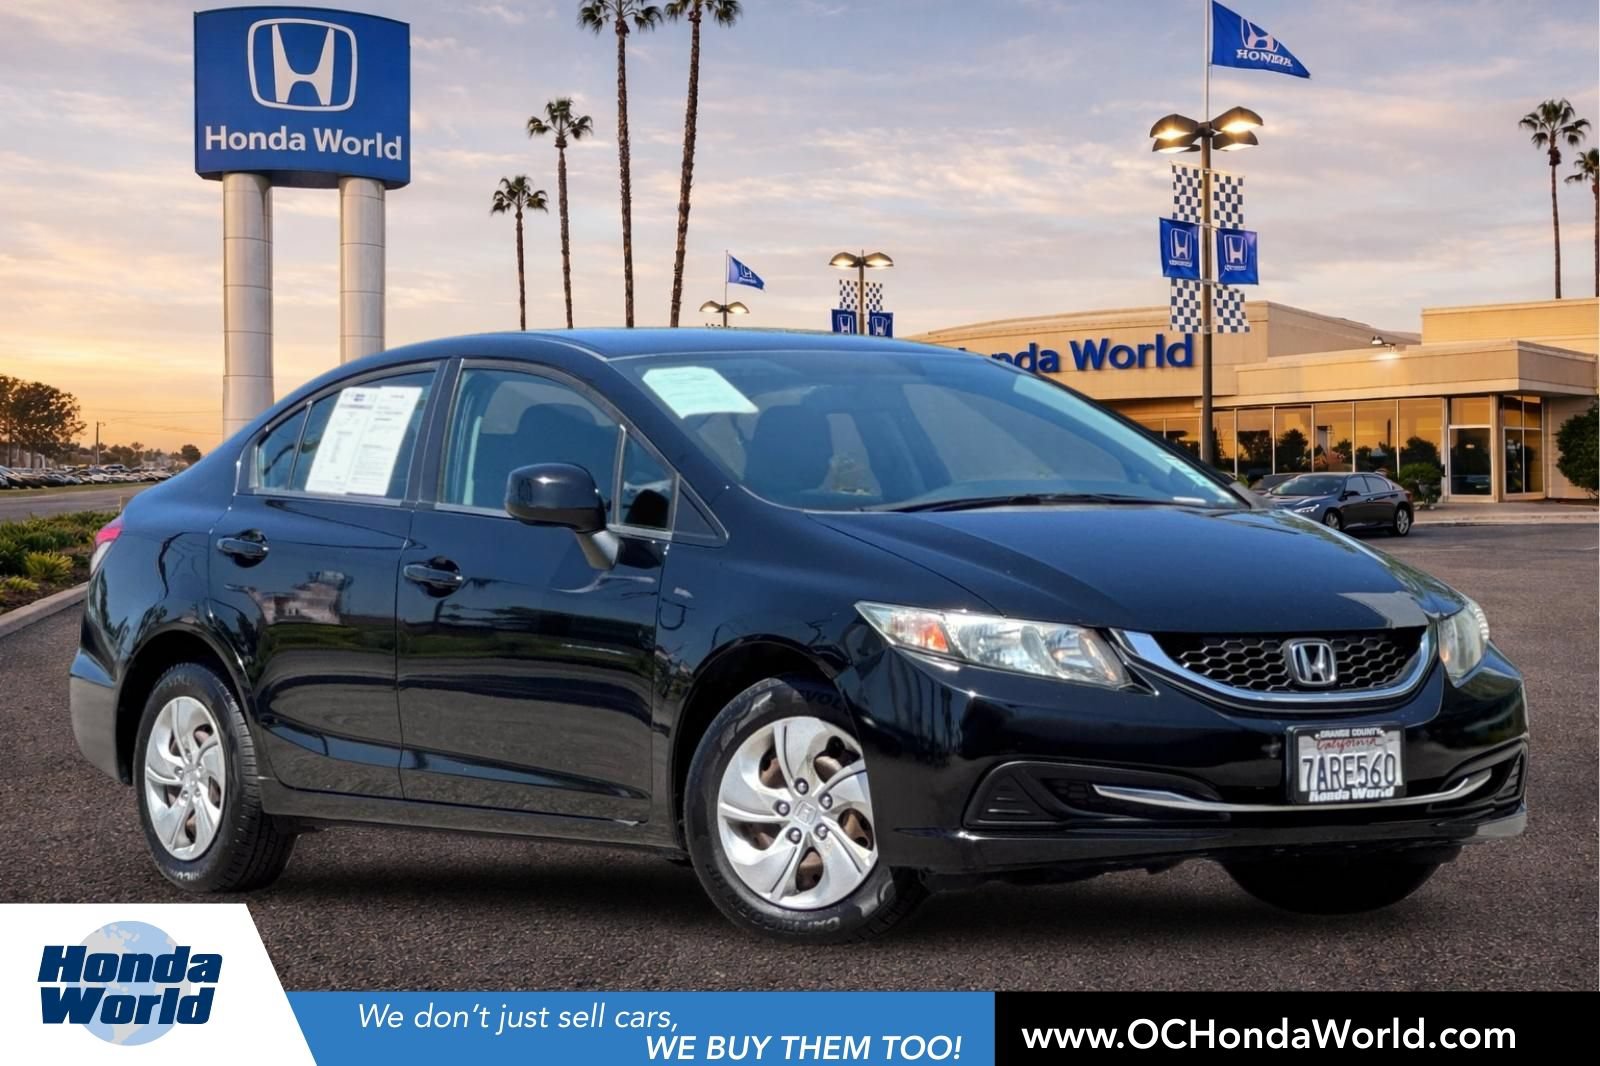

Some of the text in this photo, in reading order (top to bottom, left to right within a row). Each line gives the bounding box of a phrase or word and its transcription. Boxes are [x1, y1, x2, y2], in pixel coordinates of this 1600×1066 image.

[205, 125, 402, 161] Honda World
[1070, 333, 1194, 370] World
[1352, 728, 1381, 737] COUNTY
[1302, 753, 1396, 791] 7ARE560
[1352, 786, 1395, 800] World
